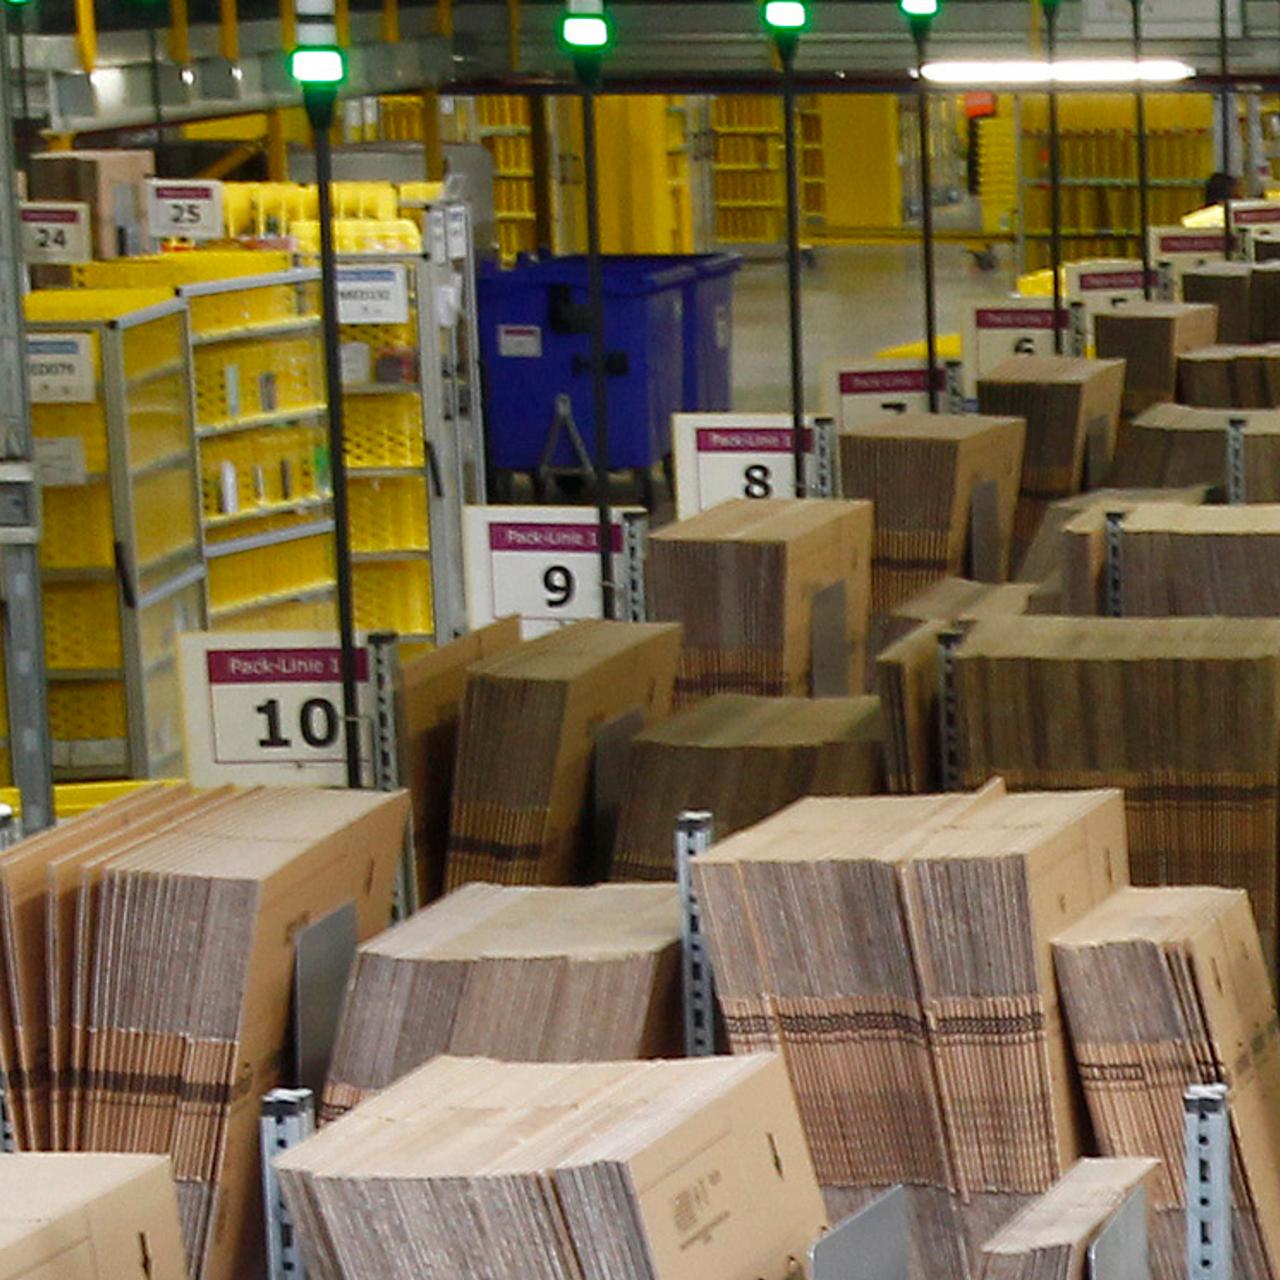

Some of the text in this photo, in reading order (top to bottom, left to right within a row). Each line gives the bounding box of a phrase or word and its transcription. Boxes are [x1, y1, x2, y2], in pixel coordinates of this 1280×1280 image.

[171, 204, 201, 223] 25
[36, 228, 67, 248] 24
[743, 463, 771, 499] 8
[543, 564, 575, 608] 9
[230, 657, 324, 674] Pack-Linie
[256, 698, 340, 748] 10
